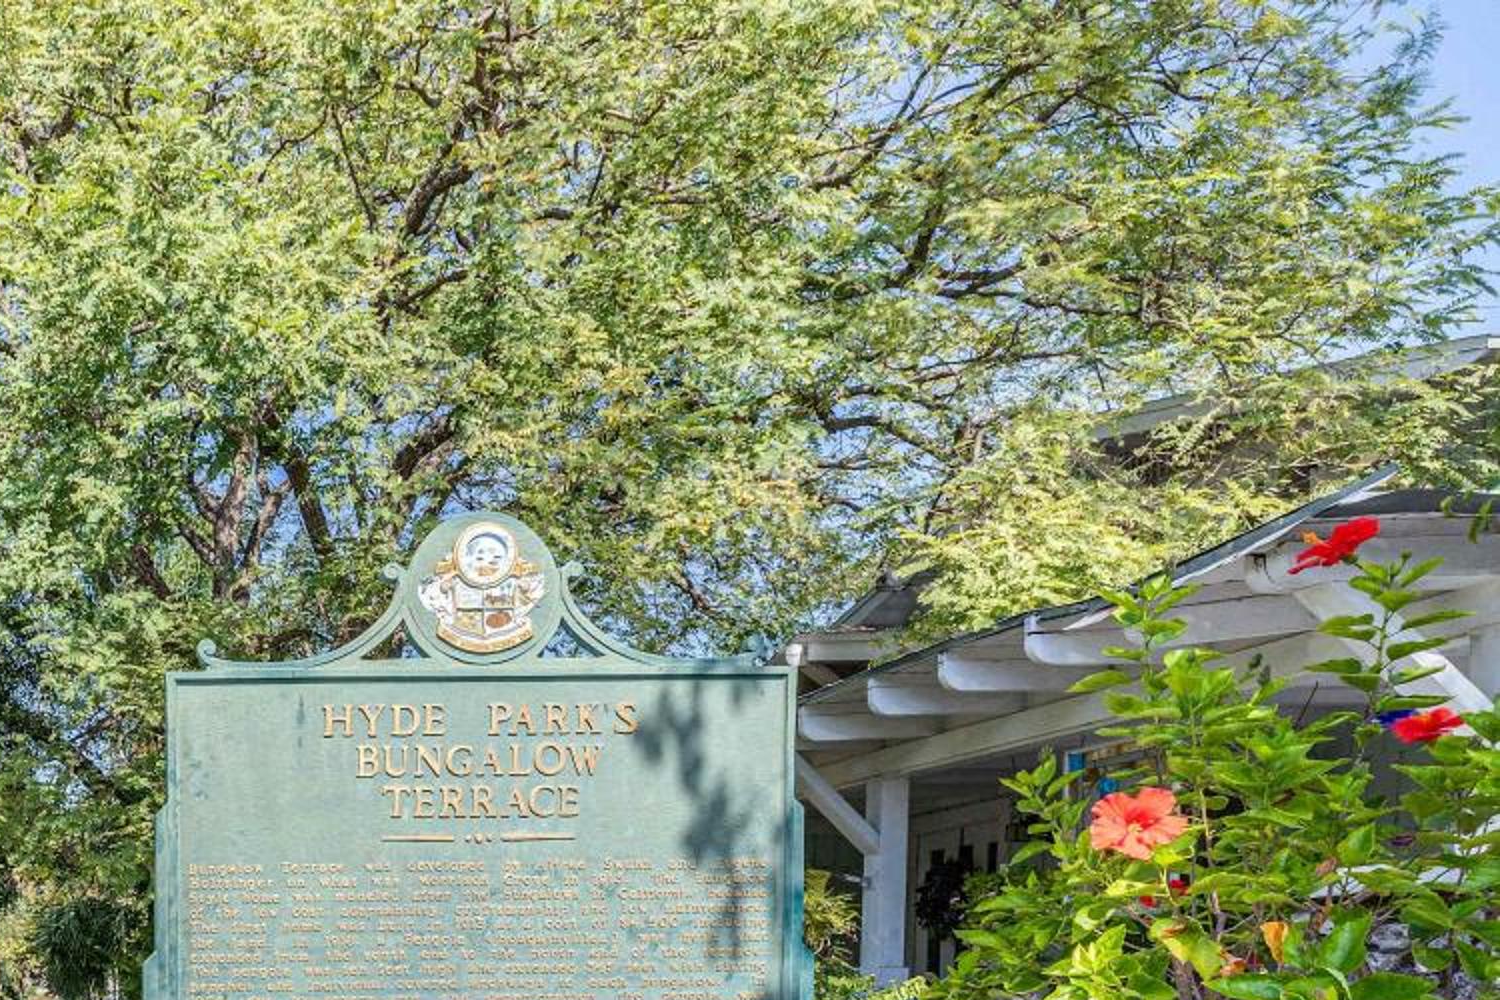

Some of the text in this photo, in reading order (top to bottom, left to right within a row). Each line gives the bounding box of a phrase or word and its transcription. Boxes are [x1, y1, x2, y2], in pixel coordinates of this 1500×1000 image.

[322, 702, 638, 738] HYDE PARK'S
[355, 741, 603, 777] BUNGALOW
[380, 783, 580, 819] TERRACE
